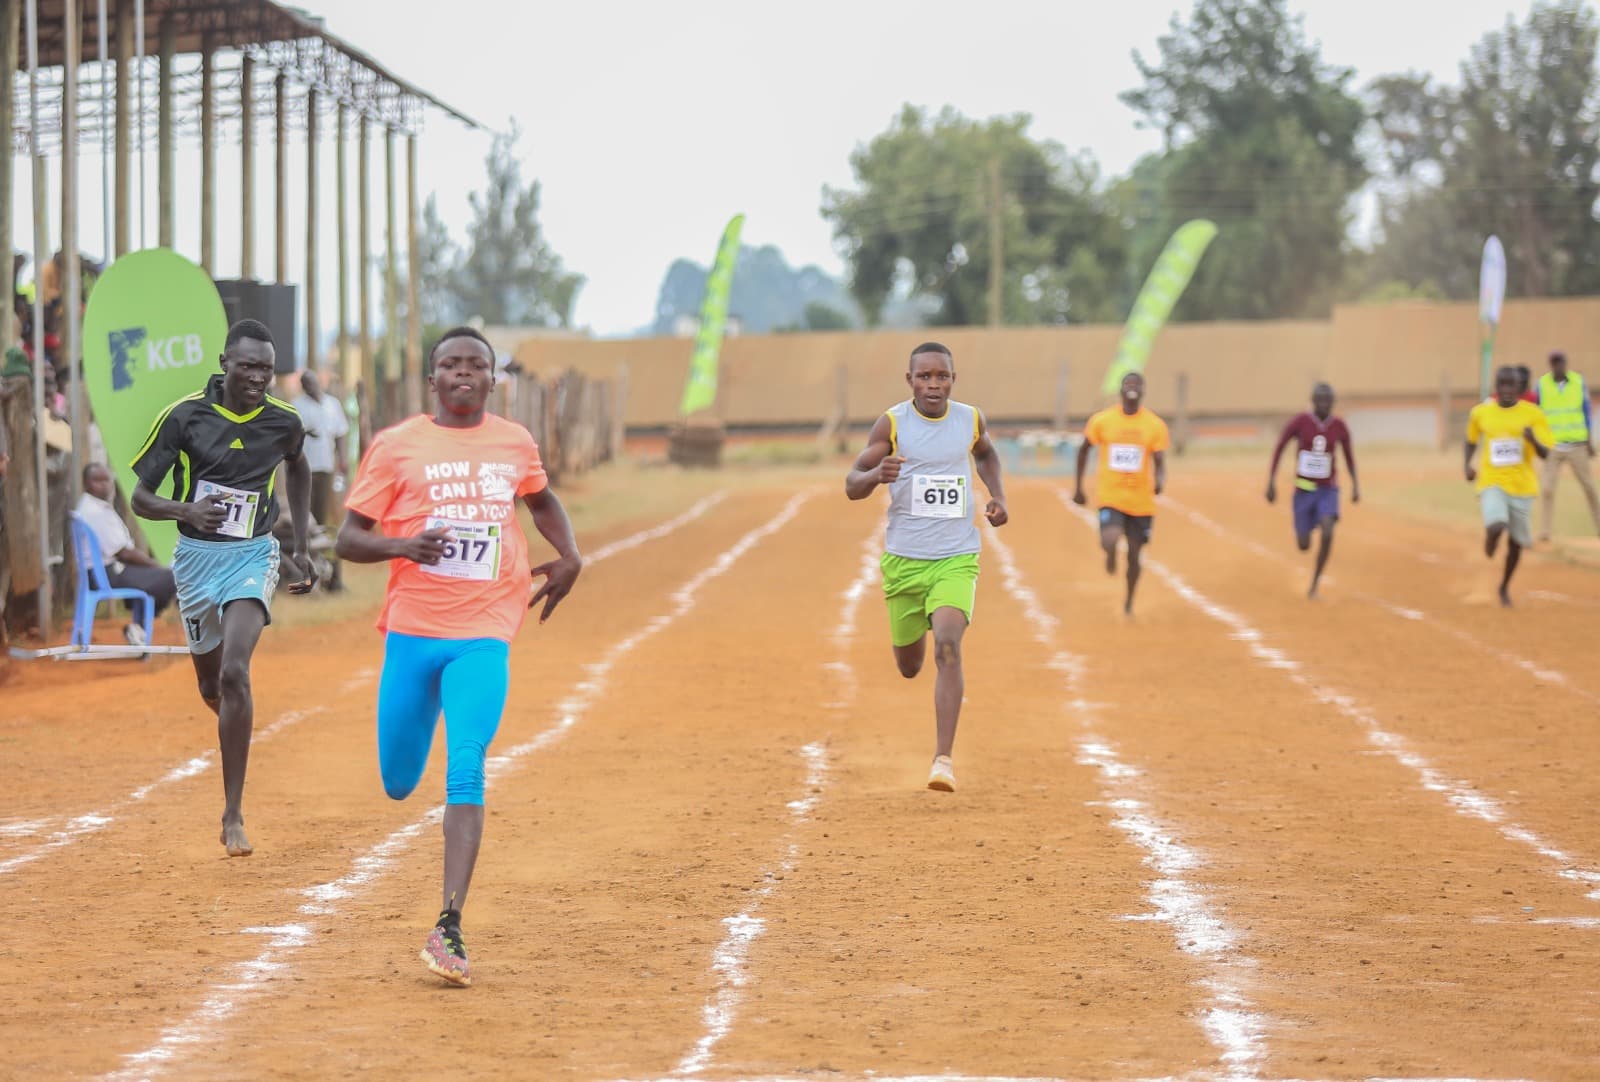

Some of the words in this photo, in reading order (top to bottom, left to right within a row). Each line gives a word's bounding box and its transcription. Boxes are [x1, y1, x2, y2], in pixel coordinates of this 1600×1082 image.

[147, 333, 203, 371] KCB
[425, 461, 470, 480] HOW
[430, 482, 467, 501] CAN
[469, 481, 477, 498] I
[924, 488, 959, 505] 619
[433, 504, 478, 520] HELP
